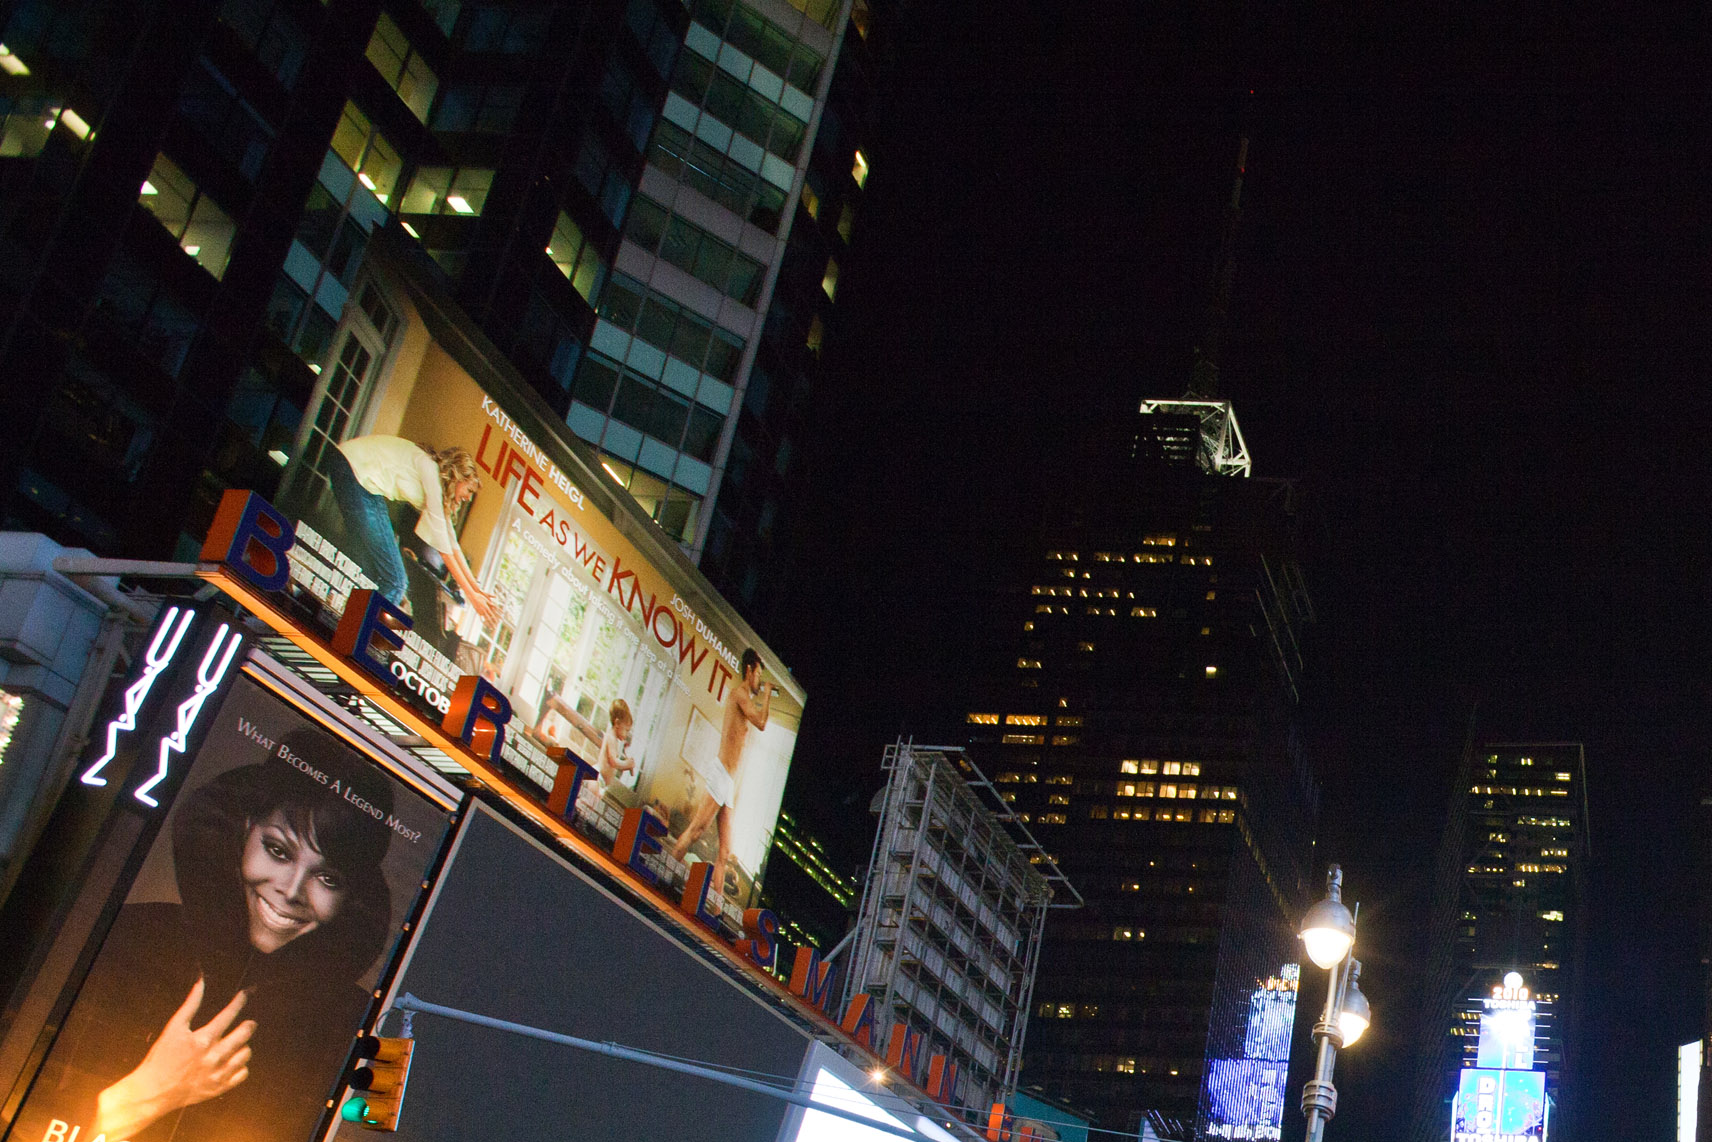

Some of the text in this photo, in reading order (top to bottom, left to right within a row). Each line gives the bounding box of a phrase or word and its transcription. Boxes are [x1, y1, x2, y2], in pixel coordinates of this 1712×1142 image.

[481, 395, 585, 511] KATHERINE HEIGL
[475, 423, 733, 703] LIFE AS WE KNOW IT
[511, 517, 660, 666] A comedy about taking one step
[670, 593, 740, 674] JOSH DUHAMEL
[201, 489, 958, 1104] BERTELSMANN
[330, 779, 341, 794] A
[1483, 999, 1536, 1010] TOSHIBA
